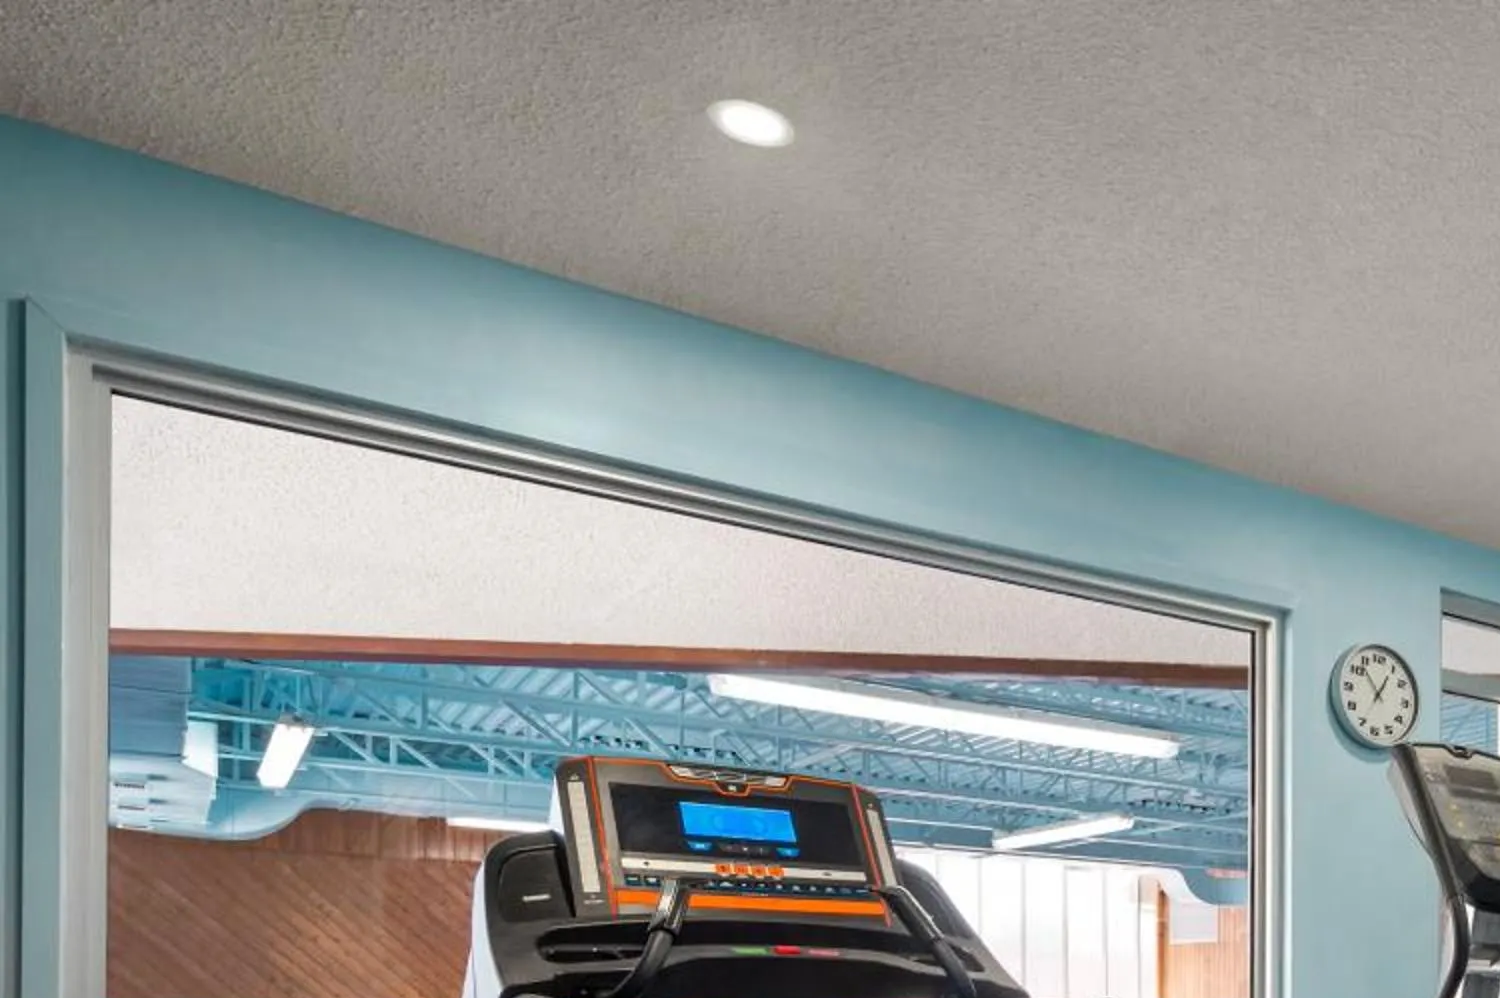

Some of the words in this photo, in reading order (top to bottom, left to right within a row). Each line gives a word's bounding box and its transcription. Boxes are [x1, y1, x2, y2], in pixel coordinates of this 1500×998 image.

[1361, 655, 1369, 666] 11
[1373, 653, 1387, 664] 12
[1351, 664, 1365, 676] 10
[1343, 681, 1354, 691] 9
[1401, 698, 1409, 709] 3
[1359, 717, 1367, 727] 7
[1394, 715, 1403, 724] 4
[1370, 726, 1379, 736] 6
[1384, 725, 1393, 735] 5
